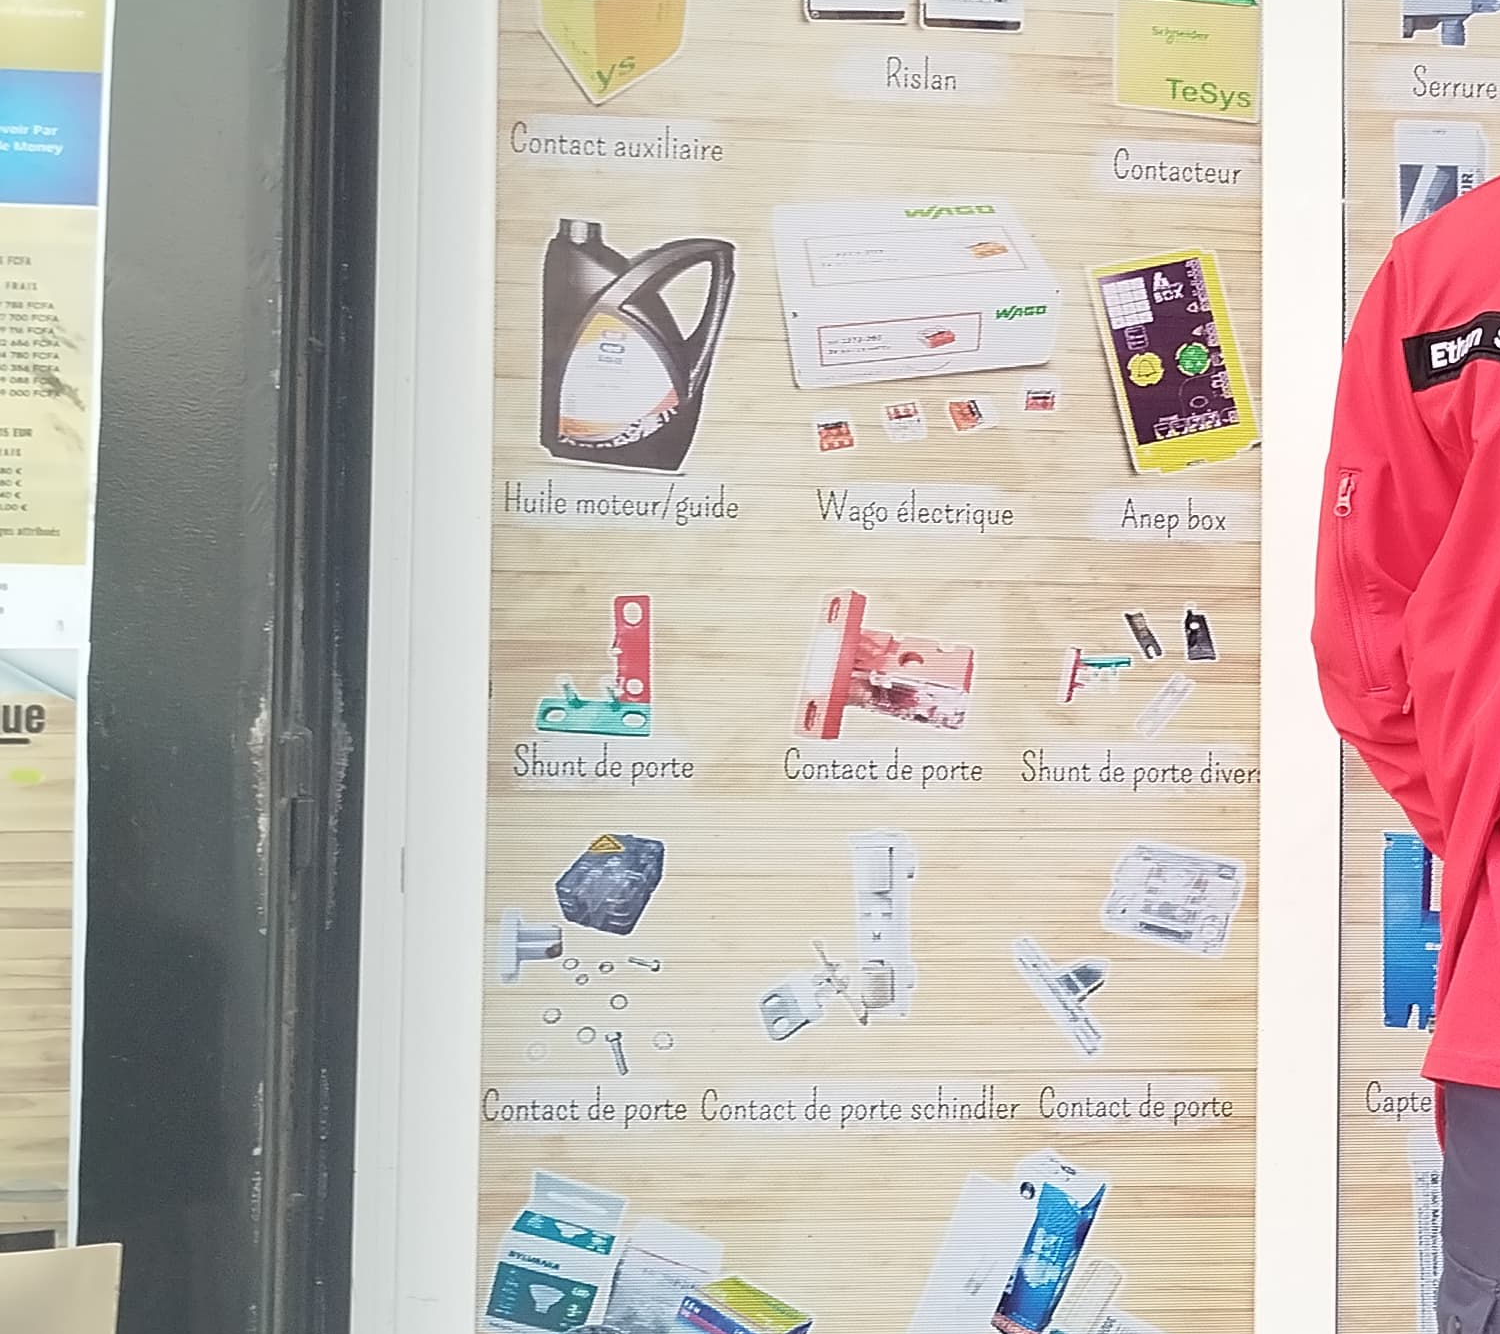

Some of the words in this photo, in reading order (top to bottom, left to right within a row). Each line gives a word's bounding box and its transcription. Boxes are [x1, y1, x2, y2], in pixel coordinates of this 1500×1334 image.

[886, 55, 957, 92] Rislan
[1166, 77, 1252, 111] TeSys
[1412, 64, 1498, 100] Serrure
[510, 122, 607, 159] Contact
[614, 125, 723, 163] auxiliaire
[1114, 148, 1242, 187] Contacteur
[1430, 327, 1484, 370] Ethn
[504, 480, 568, 517] Huile
[576, 483, 739, 526] moteur/guide
[817, 487, 888, 528] Wago
[896, 488, 1014, 528] électrique
[1122, 499, 1178, 532] Anep
[1186, 497, 1227, 531] box
[513, 743, 588, 779] Shunt
[594, 744, 624, 779] de
[631, 752, 694, 787] porte
[784, 746, 880, 782] Contact
[886, 749, 912, 782] de
[919, 755, 983, 788] porte
[1021, 747, 1092, 784] Shunt
[1097, 750, 1125, 784] de
[1130, 757, 1193, 791] porte
[482, 1088, 579, 1123] Contact
[588, 1087, 616, 1123] de
[624, 1096, 688, 1130] porte
[701, 1087, 797, 1123] Contact
[804, 1087, 832, 1122] de
[840, 1096, 902, 1130] porte
[911, 1086, 1020, 1123] schindler
[1039, 1086, 1134, 1121] Contact
[1139, 1083, 1167, 1120] de
[1174, 1094, 1234, 1127] porte
